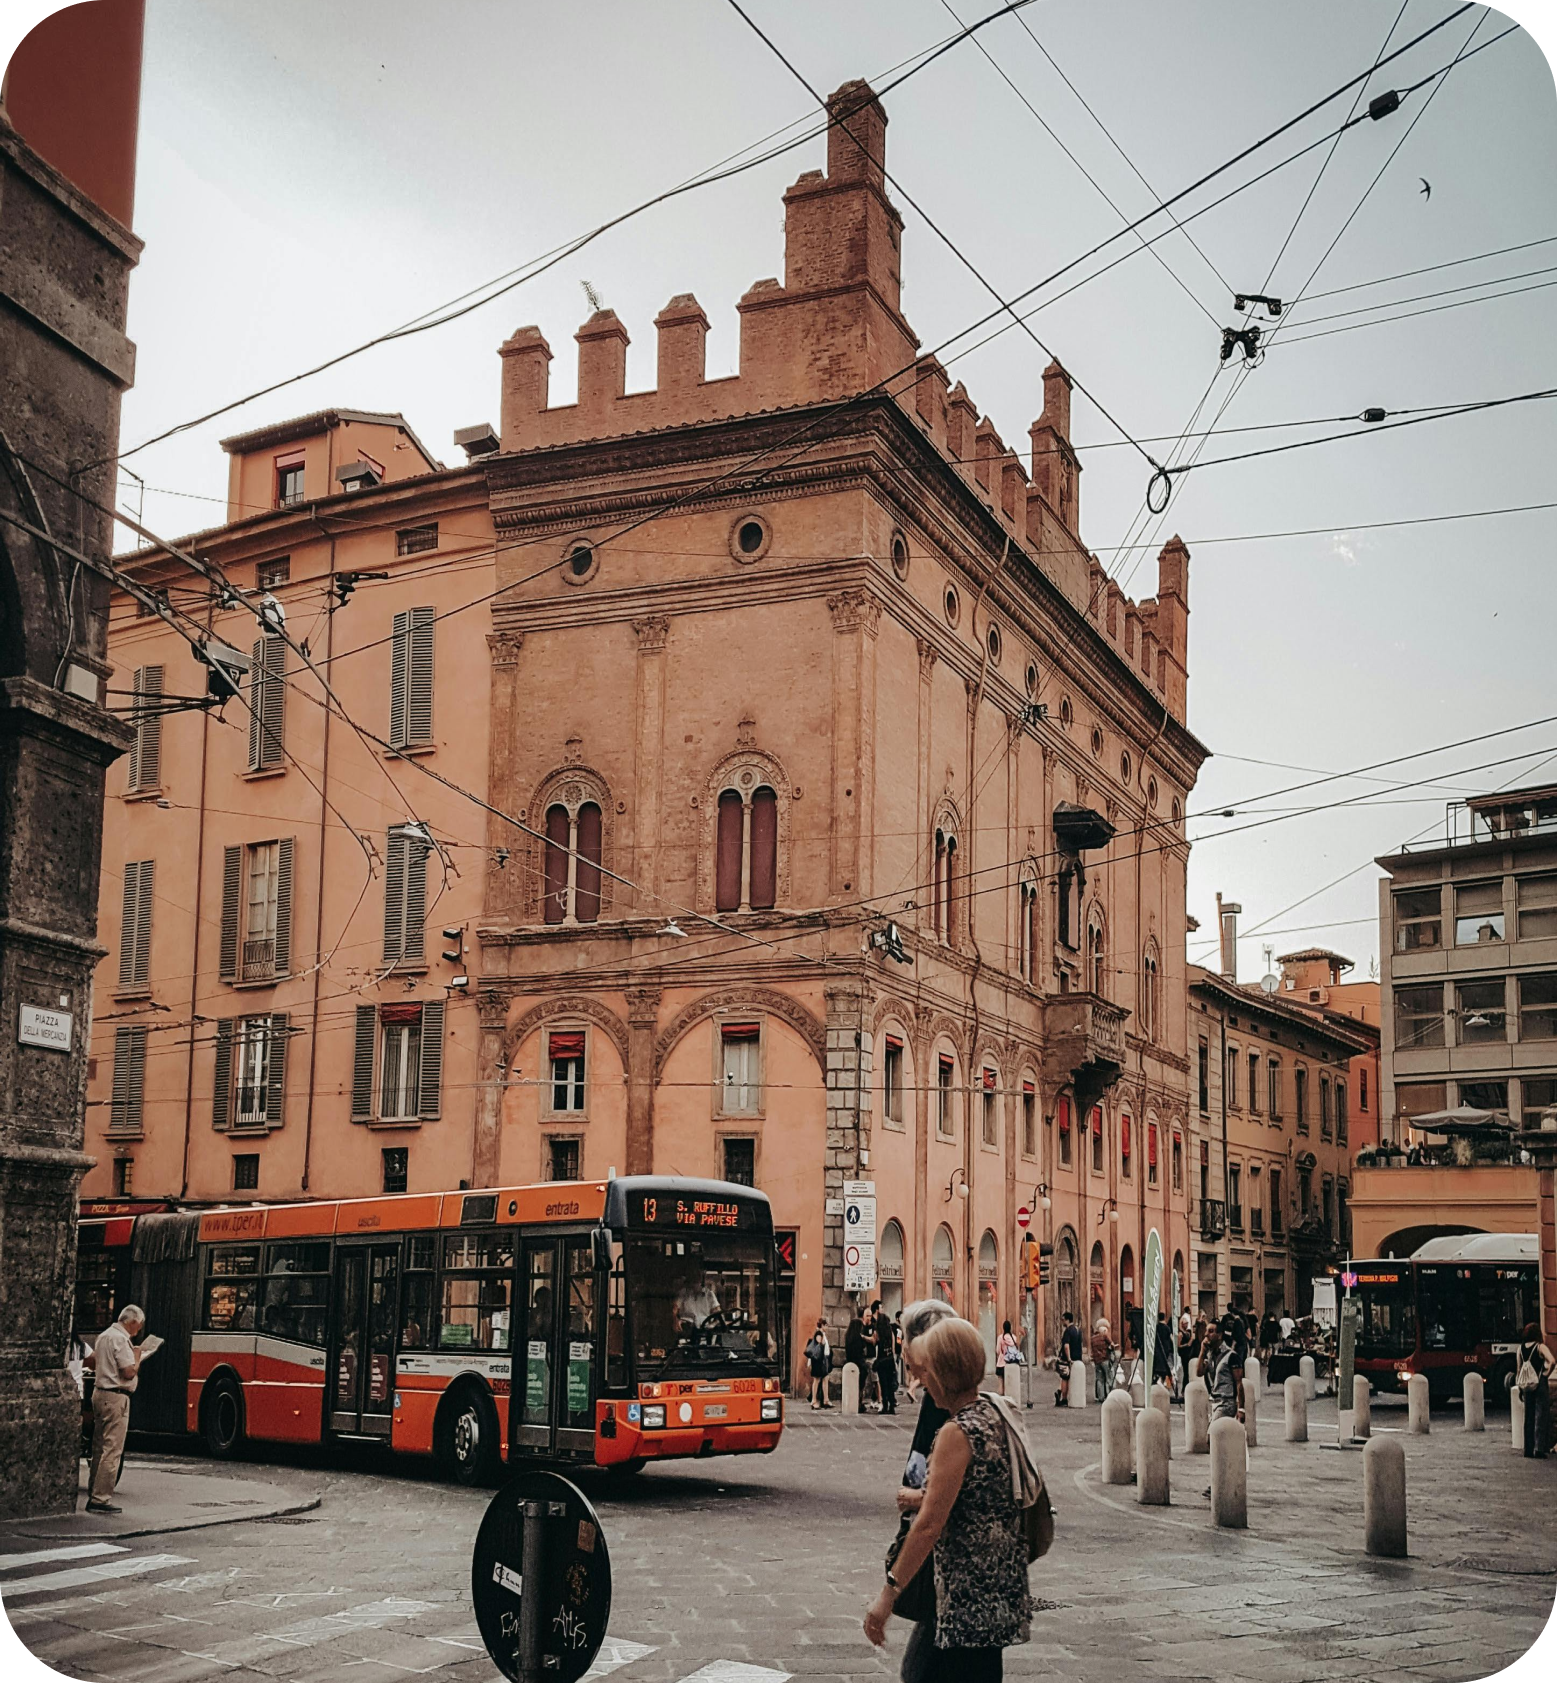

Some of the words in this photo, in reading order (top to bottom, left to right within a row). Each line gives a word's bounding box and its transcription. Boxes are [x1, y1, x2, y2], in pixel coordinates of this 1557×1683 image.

[35, 1013, 59, 1026] PIAZZA
[24, 1025, 39, 1036] DELLA
[545, 1201, 580, 1217] entrata
[644, 1198, 657, 1221] 13
[694, 1202, 738, 1215] RUFFILLO
[677, 1213, 696, 1224] VIA
[701, 1215, 738, 1227] PAVESE
[488, 1364, 510, 1374] entrata
[733, 1380, 756, 1393] 6028
